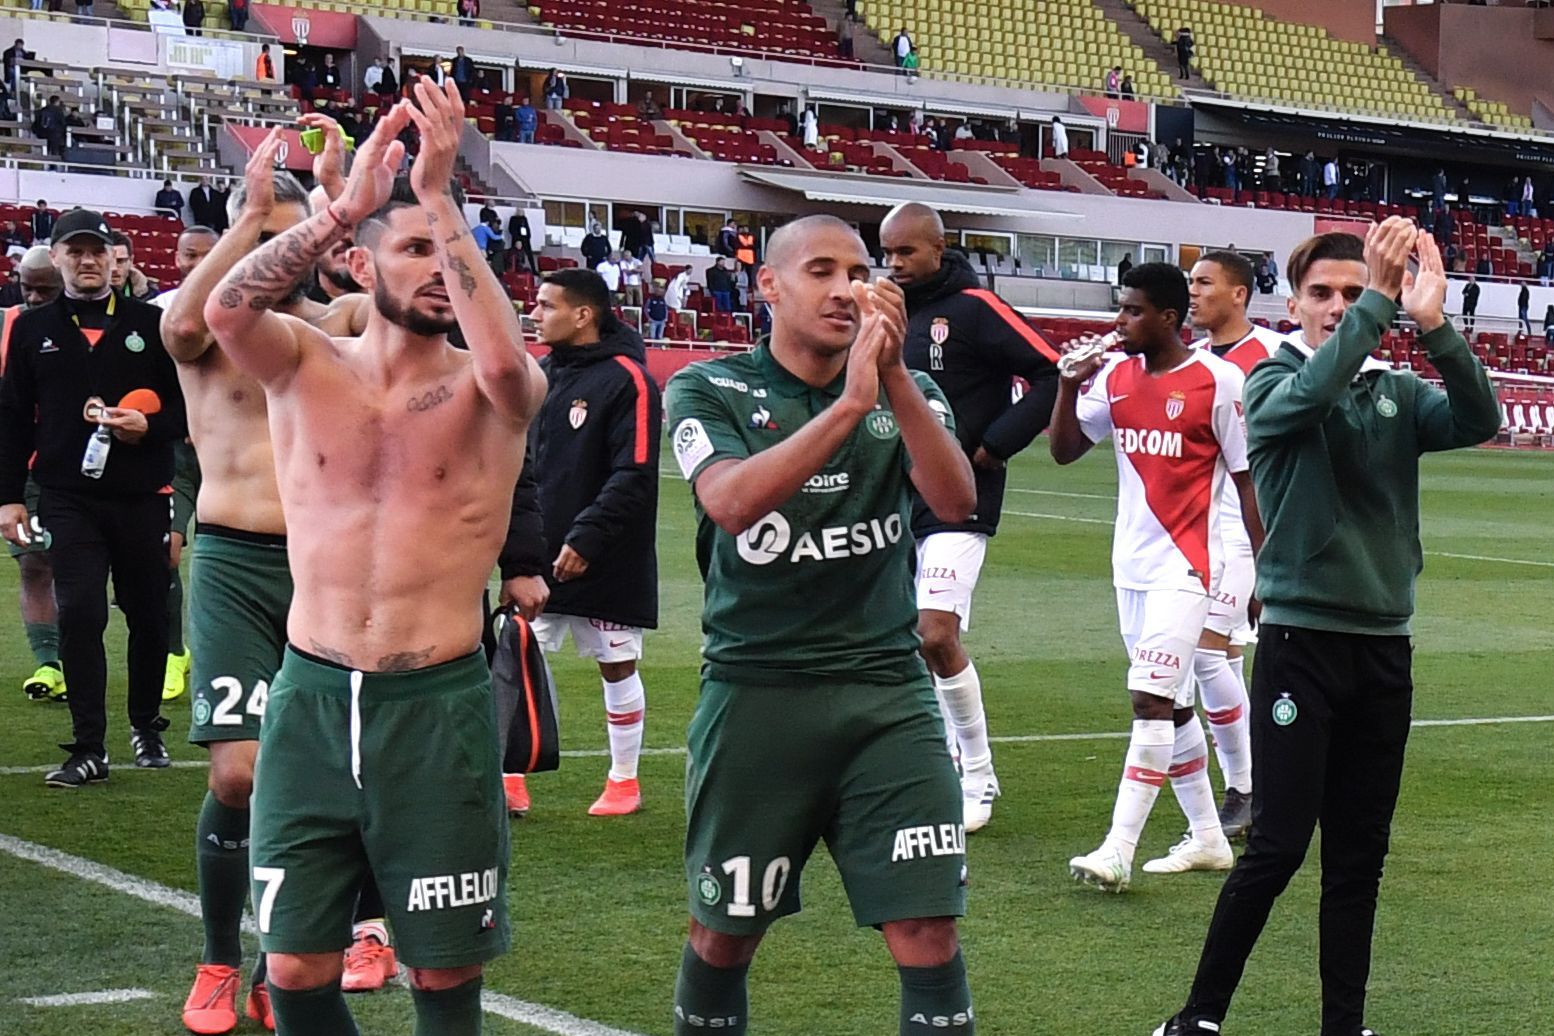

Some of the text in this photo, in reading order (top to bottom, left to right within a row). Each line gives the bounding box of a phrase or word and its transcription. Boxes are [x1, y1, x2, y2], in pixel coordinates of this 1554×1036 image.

[790, 512, 902, 564] AESIO
[210, 676, 269, 726] 24
[207, 832, 250, 850] ASS
[253, 866, 286, 934] 7
[721, 855, 791, 916] 10
